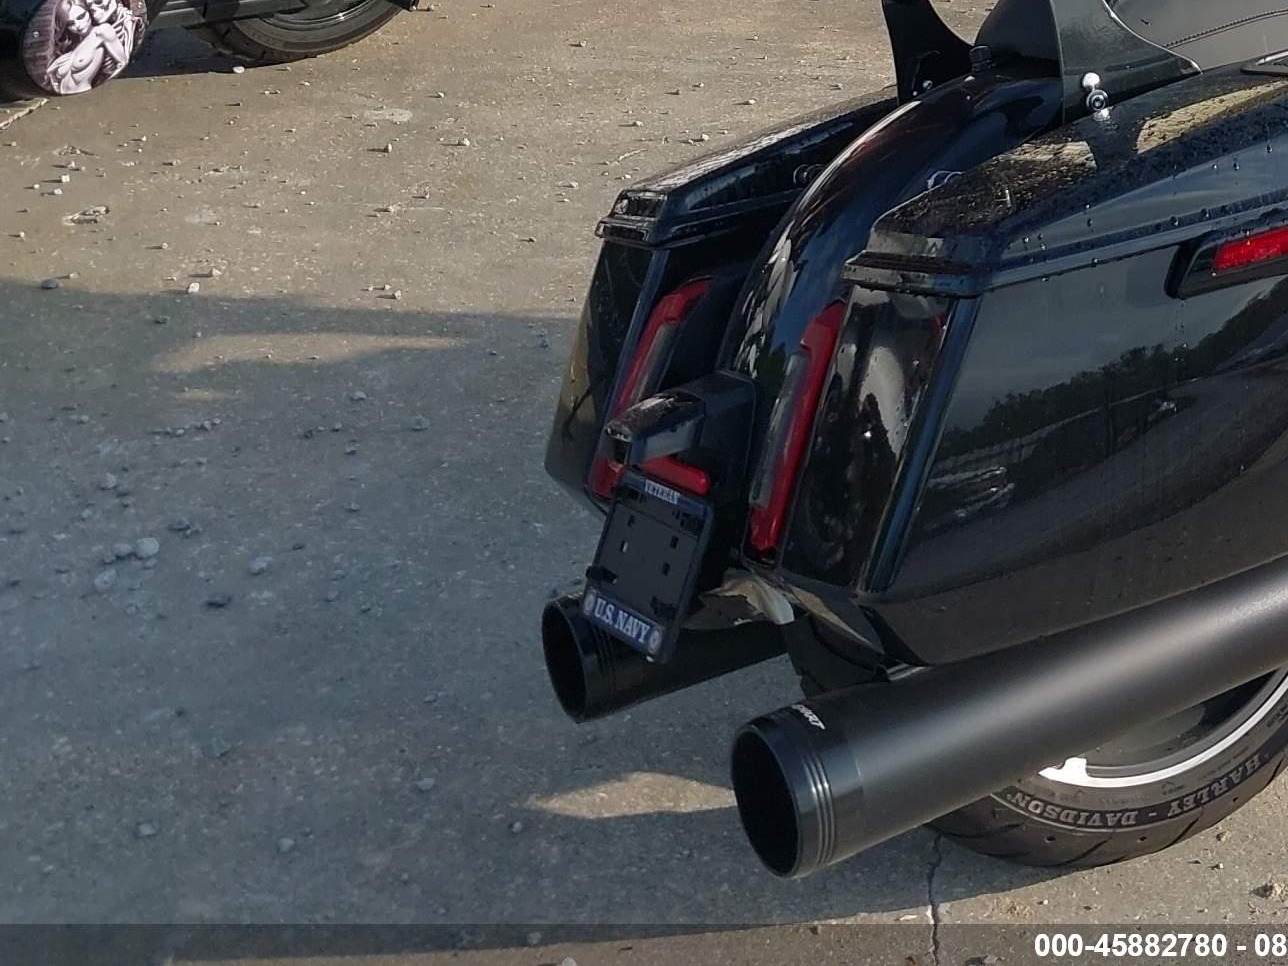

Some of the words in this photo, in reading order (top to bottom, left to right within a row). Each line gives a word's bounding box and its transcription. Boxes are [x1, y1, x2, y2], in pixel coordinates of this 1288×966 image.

[594, 597, 615, 625] U.S.
[614, 609, 651, 644] NAVY
[1011, 791, 1139, 827] DAVIDSON
[1166, 753, 1263, 818] HARLEY
